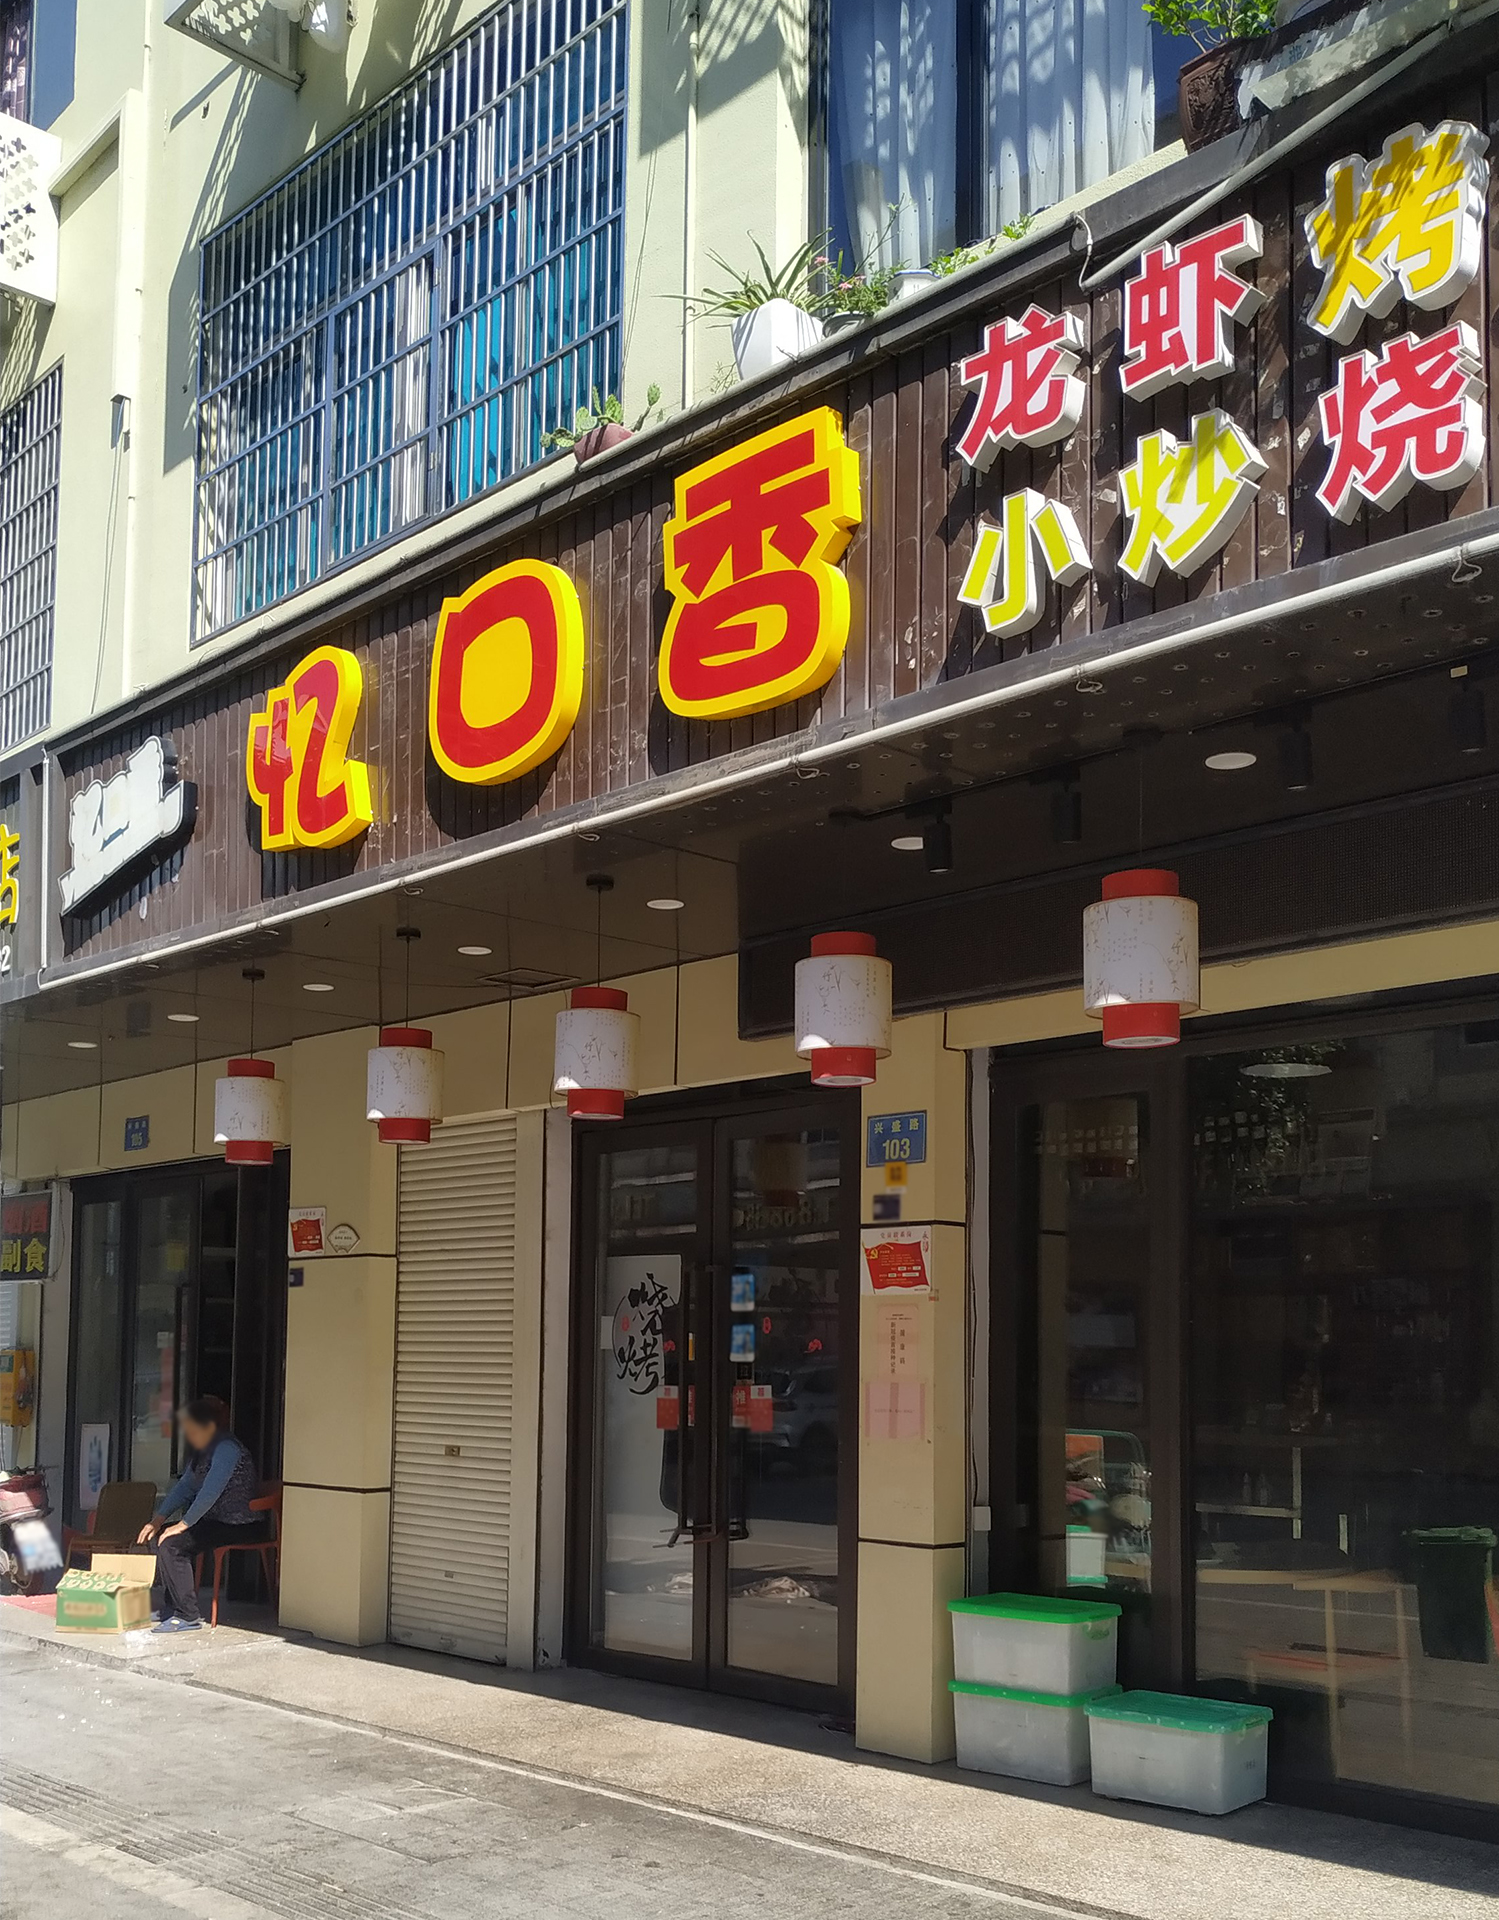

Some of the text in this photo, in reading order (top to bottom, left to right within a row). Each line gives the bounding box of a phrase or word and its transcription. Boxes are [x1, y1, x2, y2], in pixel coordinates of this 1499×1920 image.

[874, 1118, 919, 1134] 兴盛路
[883, 1138, 910, 1160] 103
[1, 1238, 47, 1273] 副食
[617, 1272, 668, 1396] 烧烤
